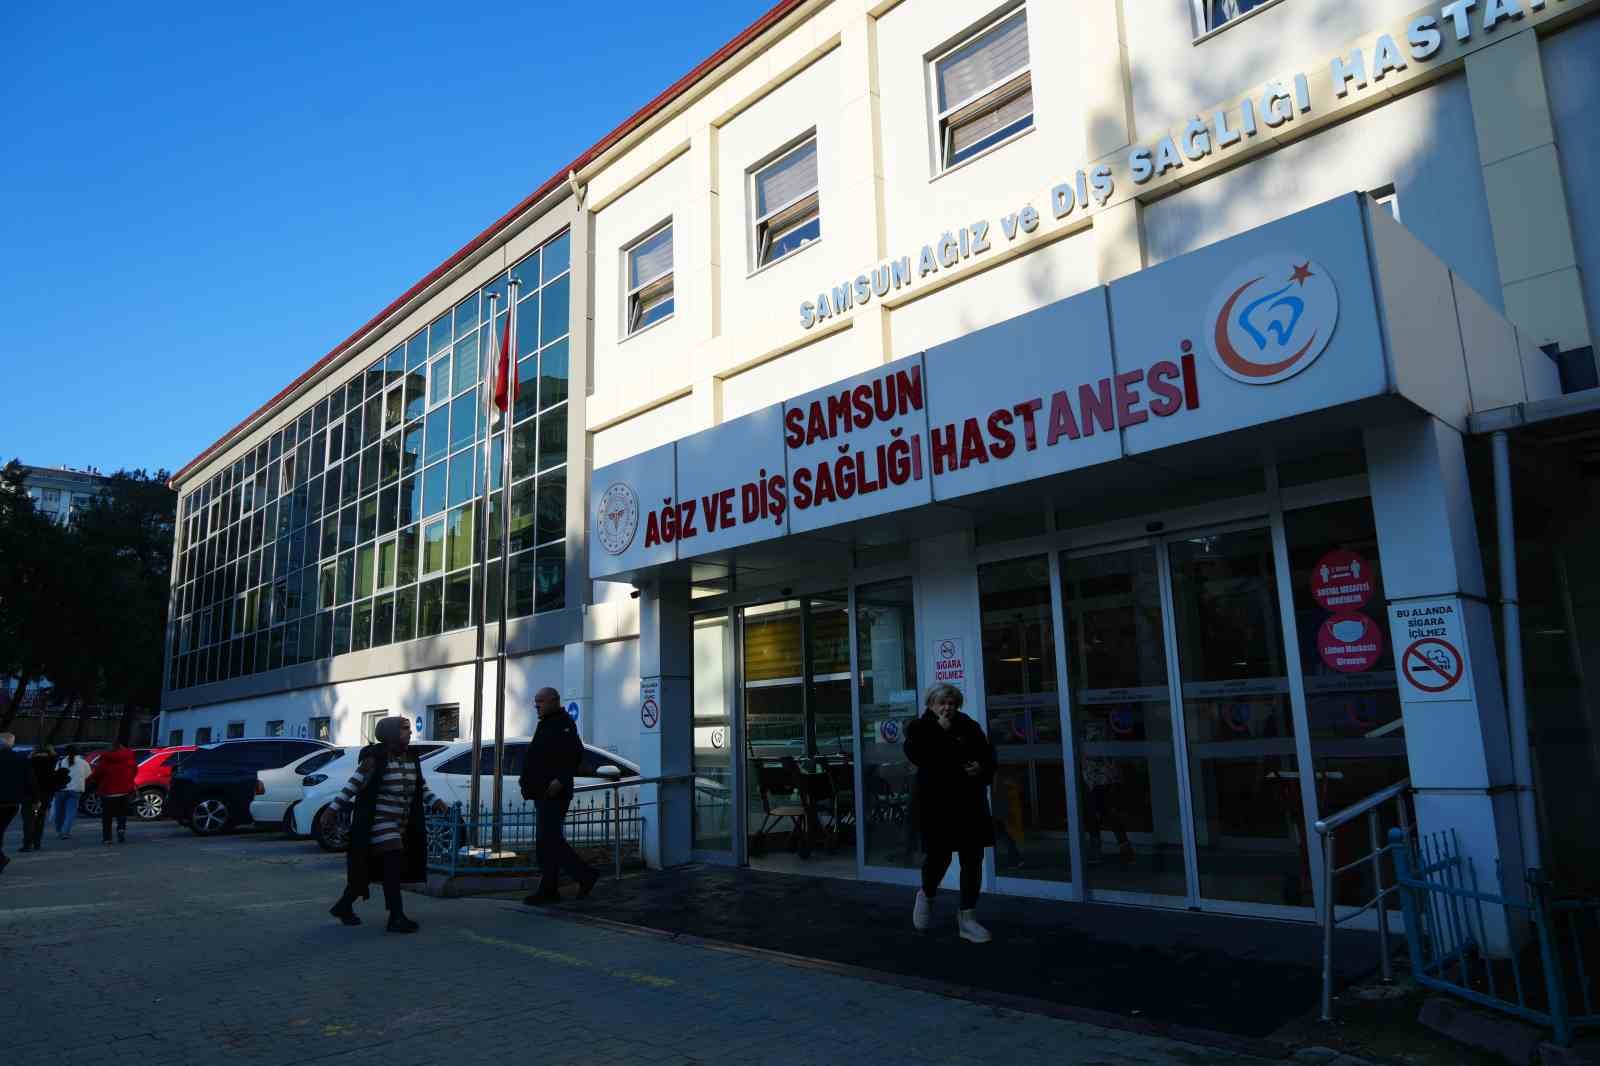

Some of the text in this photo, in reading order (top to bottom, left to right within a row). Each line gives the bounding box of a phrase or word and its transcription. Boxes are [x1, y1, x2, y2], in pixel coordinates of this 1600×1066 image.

[799, 0, 1549, 329] SAMSUN AĞIZ ve DİŞ SAĞLIĞI HASTA
[785, 365, 923, 449] SAMSUN
[644, 339, 1200, 548] AĞIZ VE DİŞ SAĞLIĞI HASTANESİ
[1396, 605, 1454, 618] BU ALANDA
[1407, 617, 1445, 628] SİGARA
[1408, 627, 1447, 639] İÇİLMEZ
